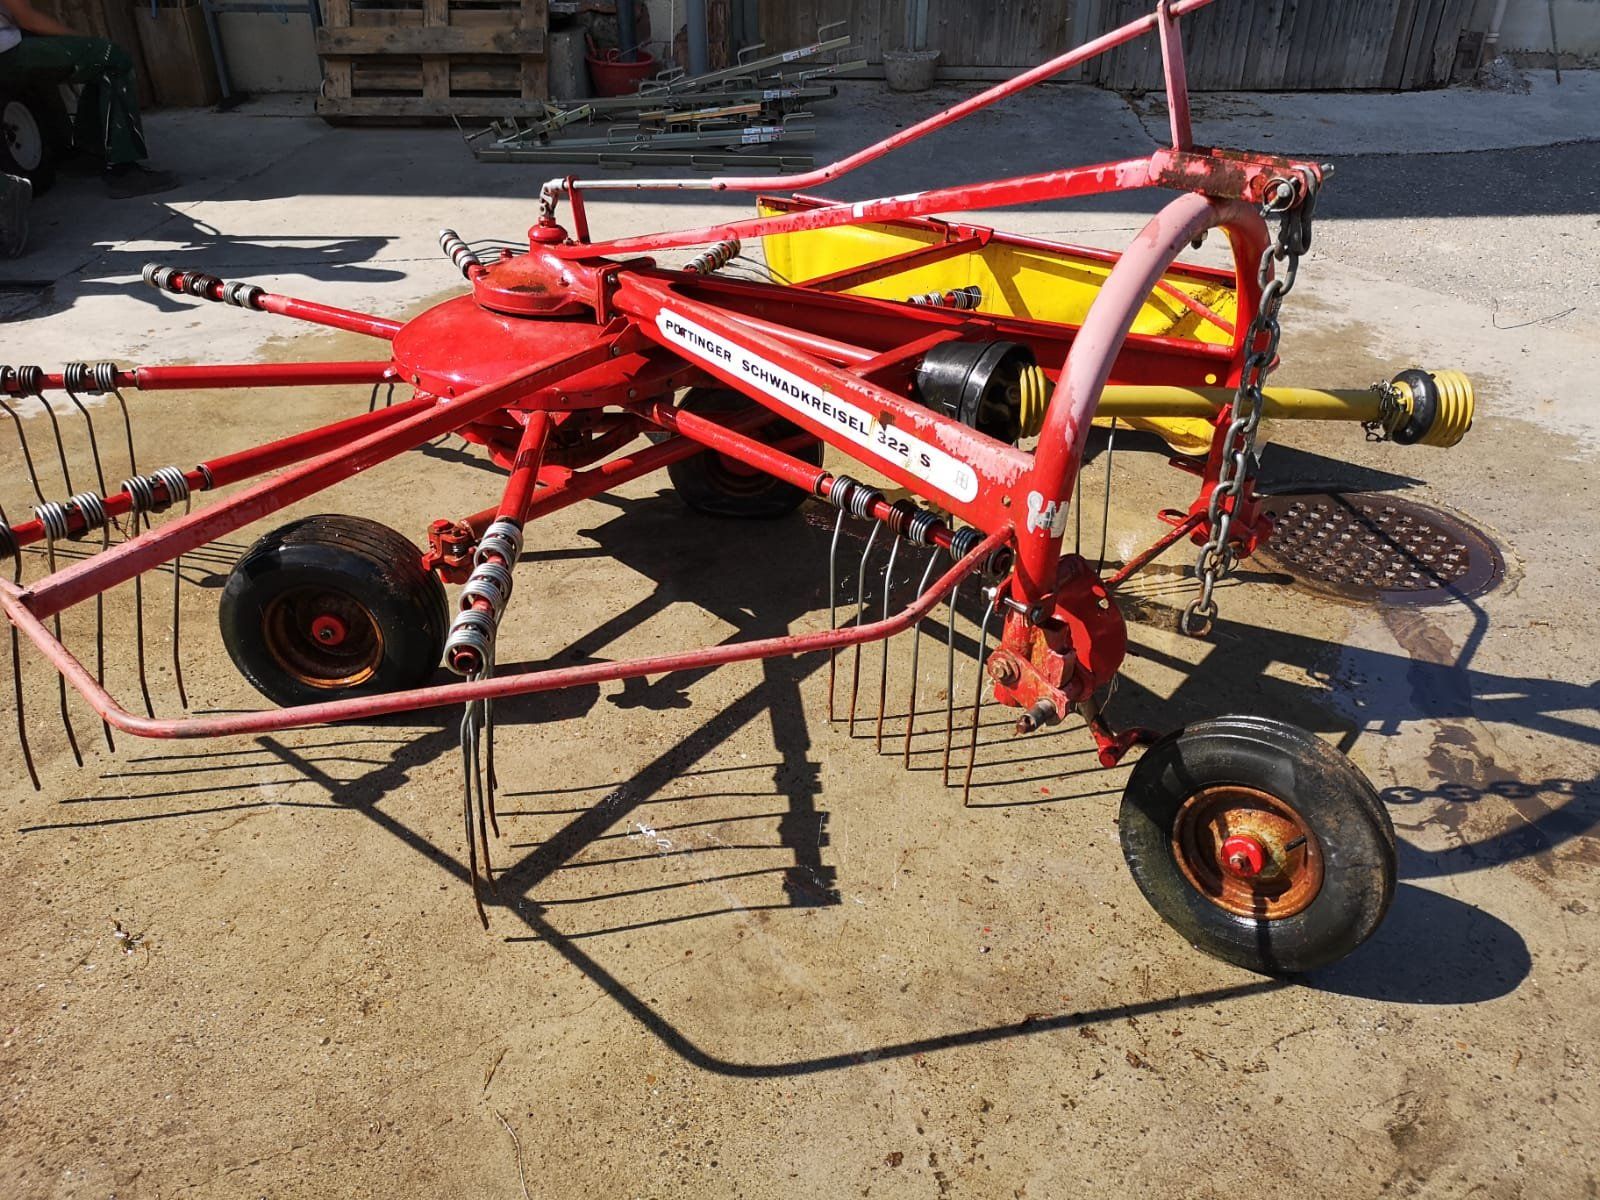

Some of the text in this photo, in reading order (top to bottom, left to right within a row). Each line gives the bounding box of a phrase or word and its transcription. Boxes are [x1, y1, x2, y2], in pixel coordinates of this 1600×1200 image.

[742, 359, 870, 437] SCHWADKREISEL
[877, 431, 910, 457] 322
[920, 452, 931, 468] S
